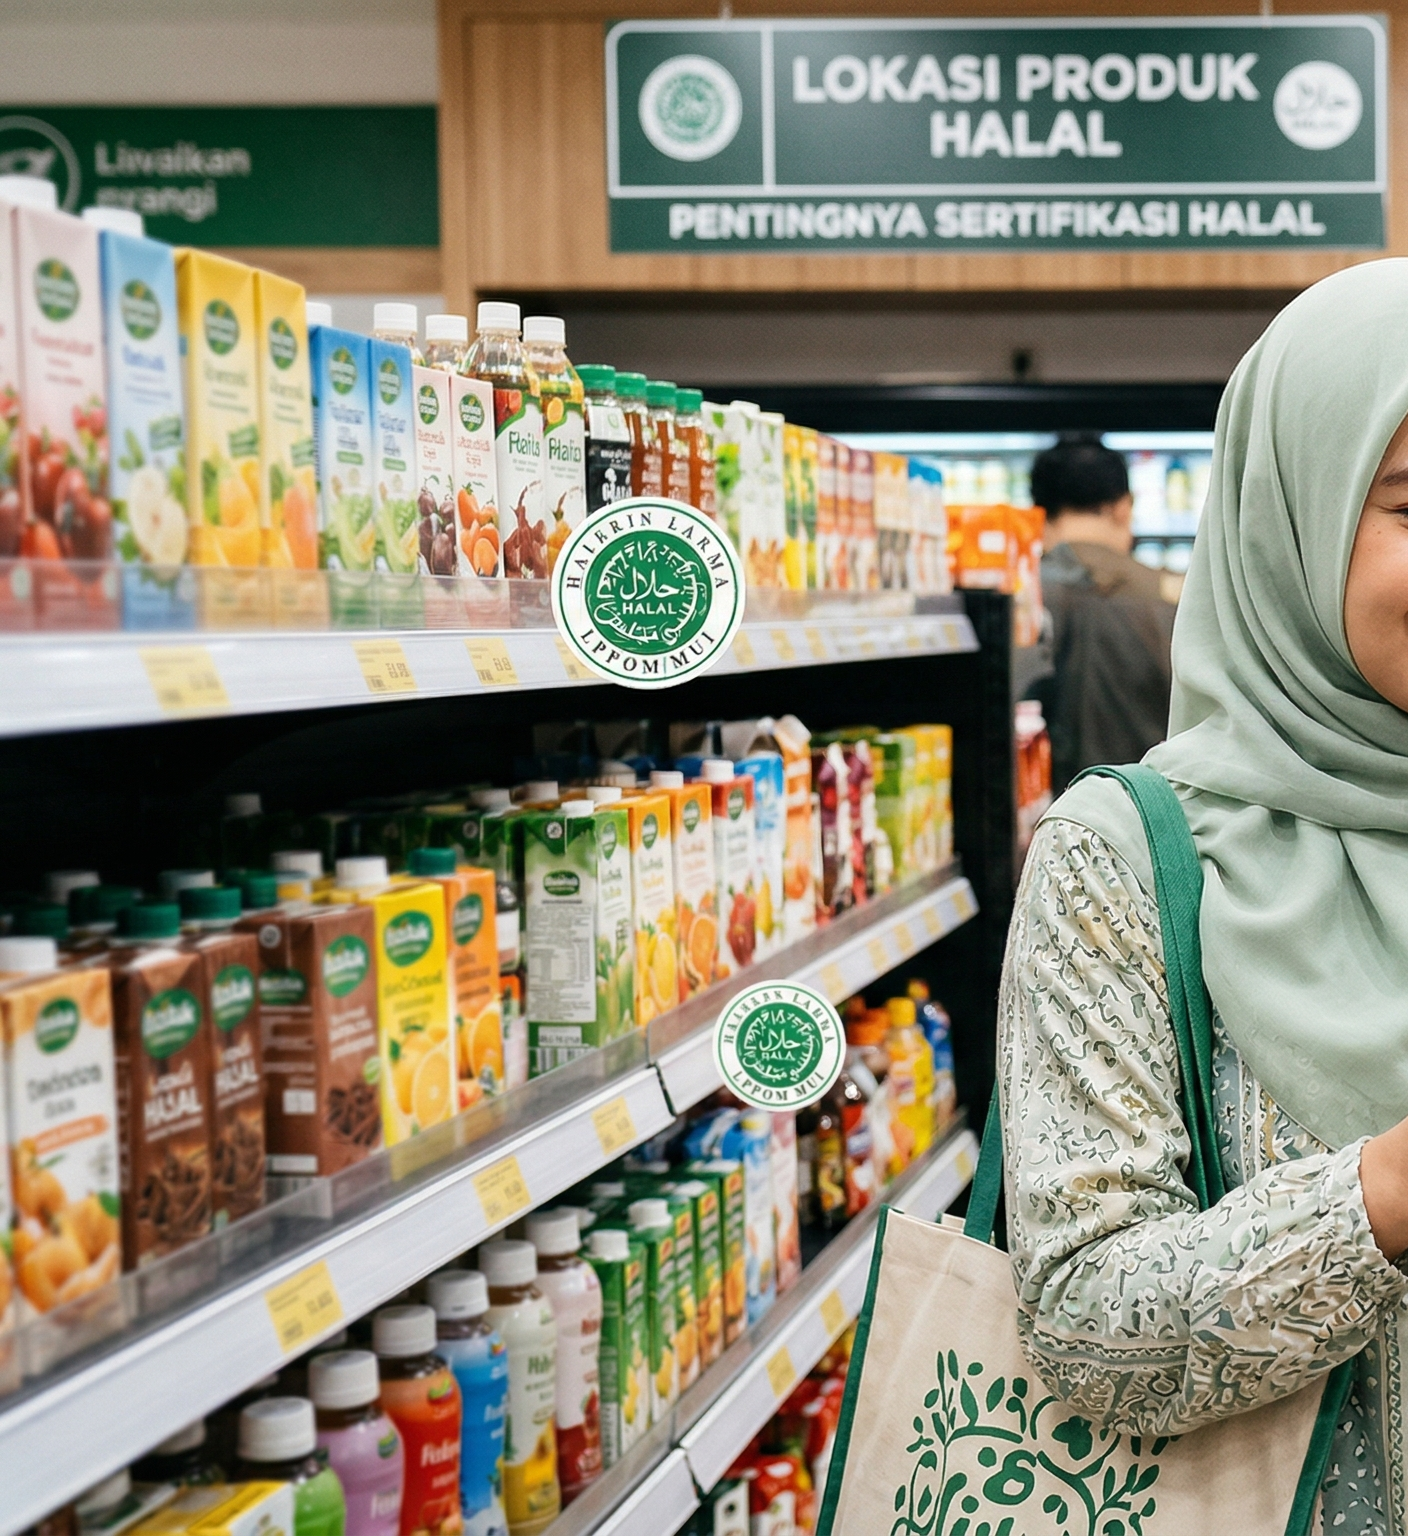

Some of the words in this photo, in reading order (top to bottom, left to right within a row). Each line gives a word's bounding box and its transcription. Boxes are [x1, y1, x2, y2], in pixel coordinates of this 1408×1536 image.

[792, 54, 1000, 103] LOKASI
[1015, 52, 1261, 102] PRODUK
[930, 109, 1123, 159] HALAL
[668, 202, 928, 240] PENTINGNYA
[934, 200, 1179, 239] SERTIFIKASI
[1188, 200, 1327, 237] HALAL
[620, 567, 680, 600] حلال
[623, 602, 677, 615] HALAL
[759, 1028, 802, 1051] حلال
[732, 1070, 788, 1101] LPPOM
[795, 1071, 825, 1098] MUI
